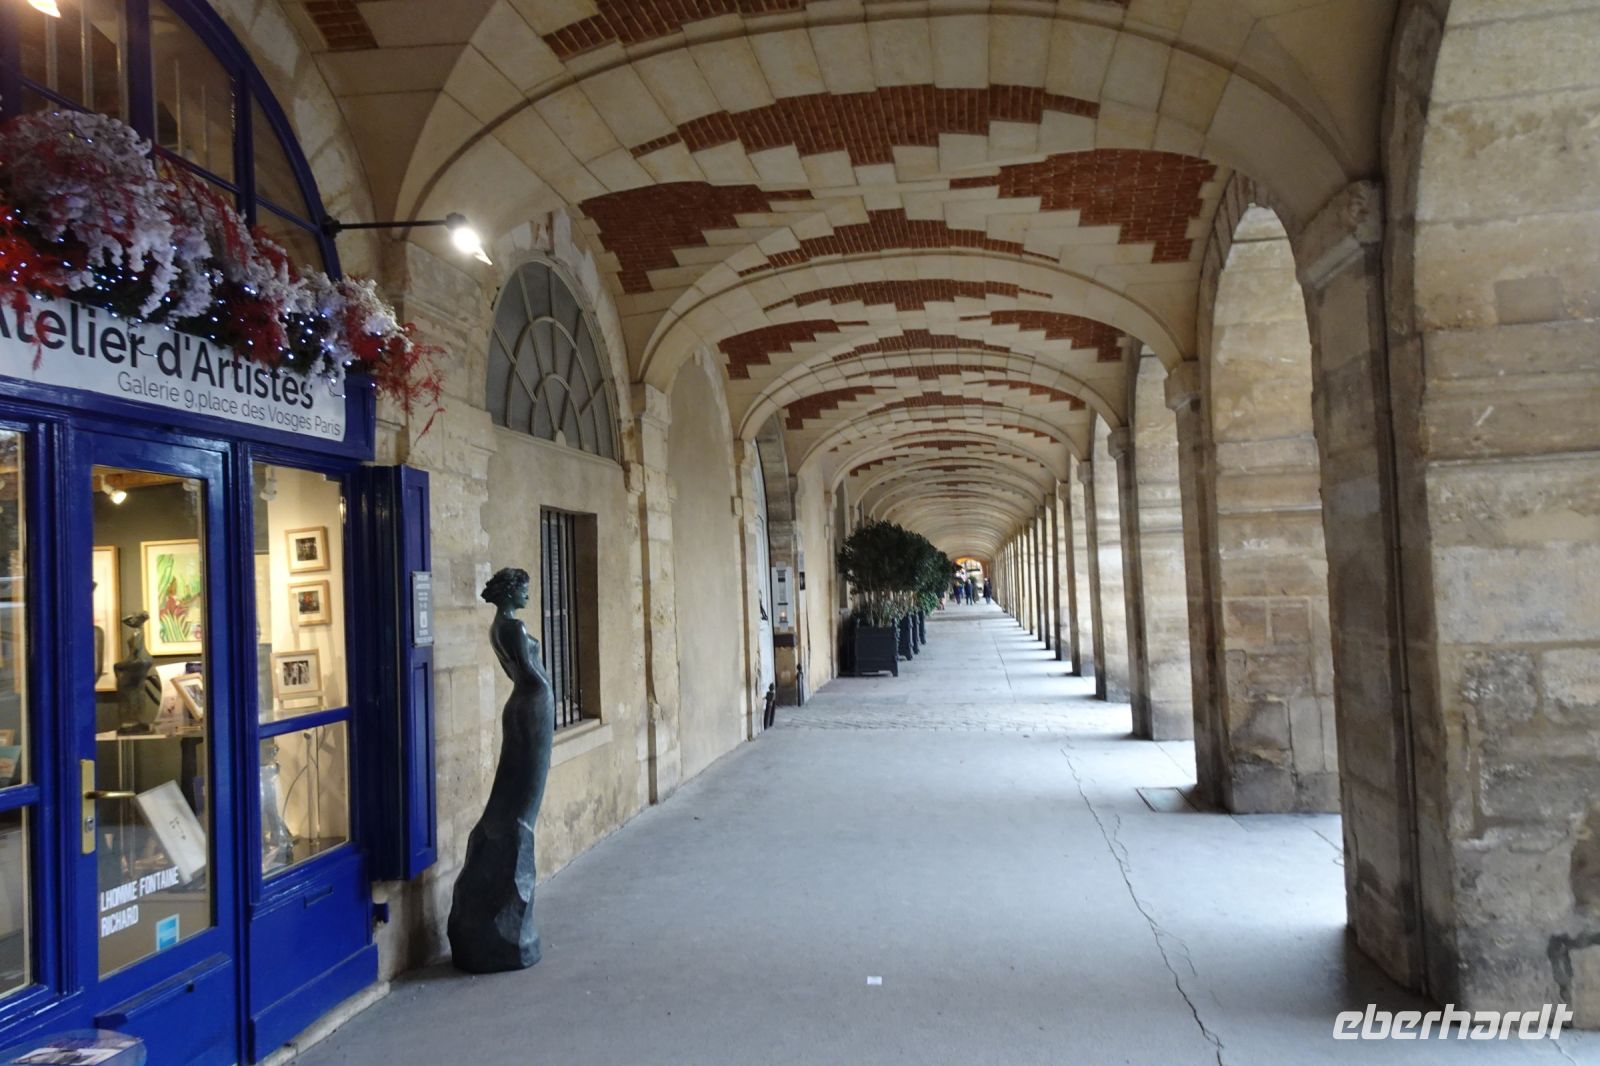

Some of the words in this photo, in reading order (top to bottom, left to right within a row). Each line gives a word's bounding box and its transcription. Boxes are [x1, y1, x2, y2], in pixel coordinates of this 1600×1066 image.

[117, 371, 180, 401] Galerie
[241, 401, 265, 421] des
[268, 405, 312, 432] Vosges
[315, 416, 341, 436] Paris
[157, 333, 314, 409] d'Artistes
